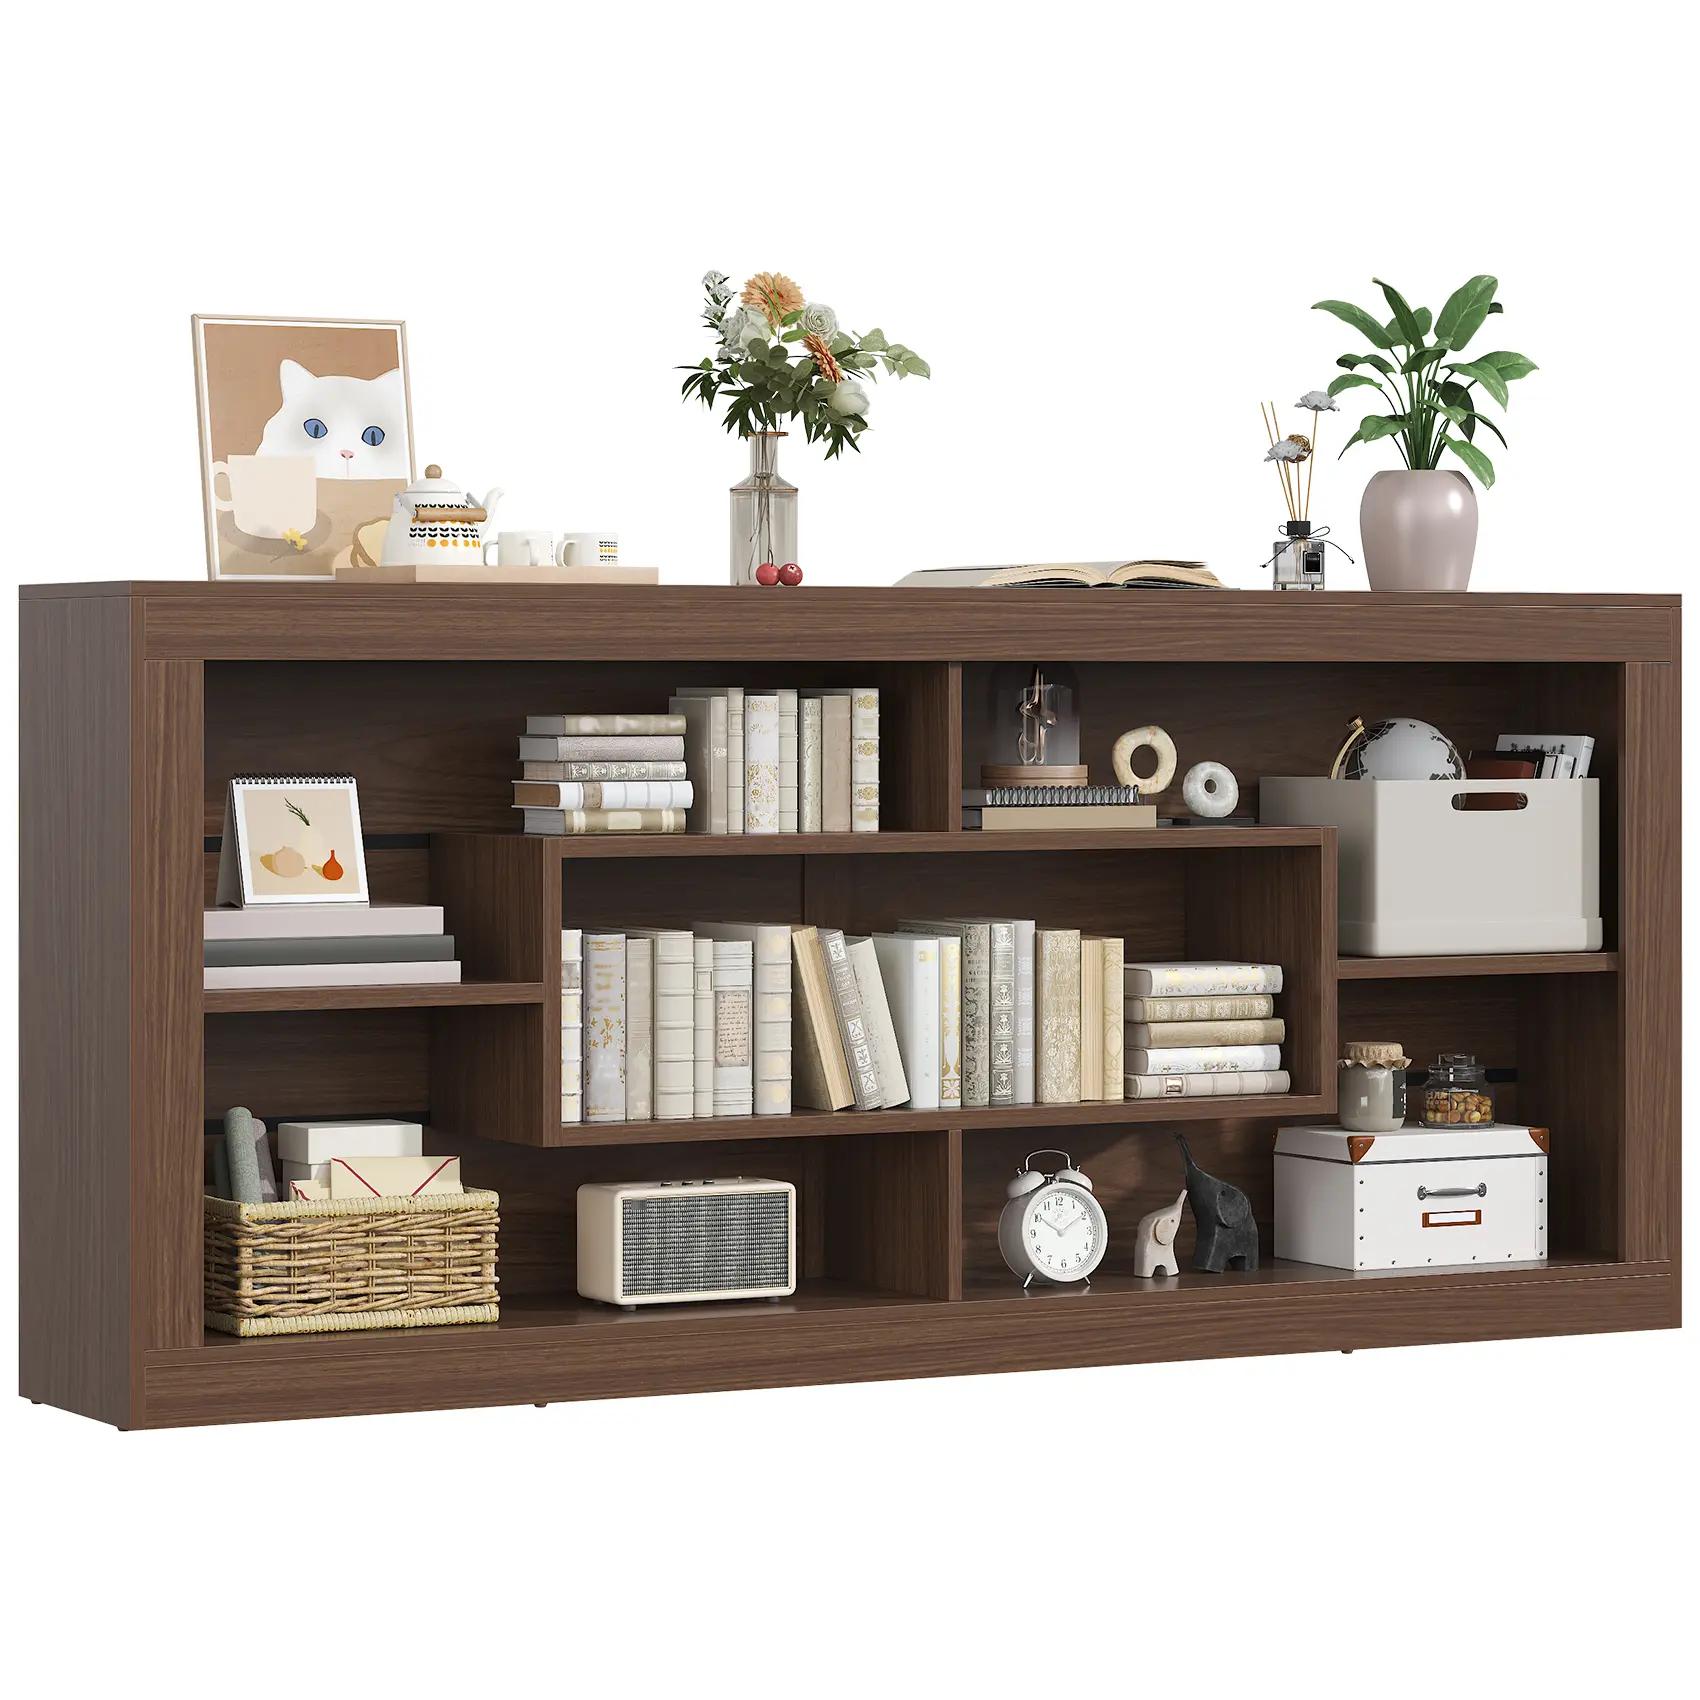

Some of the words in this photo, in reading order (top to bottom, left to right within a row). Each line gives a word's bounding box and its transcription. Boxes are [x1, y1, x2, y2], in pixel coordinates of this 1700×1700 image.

[1043, 1201, 1050, 1210] 11
[1055, 1196, 1064, 1206] 12
[1072, 1200, 1076, 1209] 1
[1034, 1213, 1042, 1222] 10
[1081, 1210, 1086, 1220] 2
[1030, 1229, 1036, 1239] 9
[1086, 1226, 1092, 1236] 3
[1035, 1245, 1042, 1254] 8
[1084, 1242, 1088, 1251] 4
[1047, 1255, 1052, 1265] 7
[1076, 1253, 1081, 1263] 5
[1061, 1259, 1067, 1268] 6
